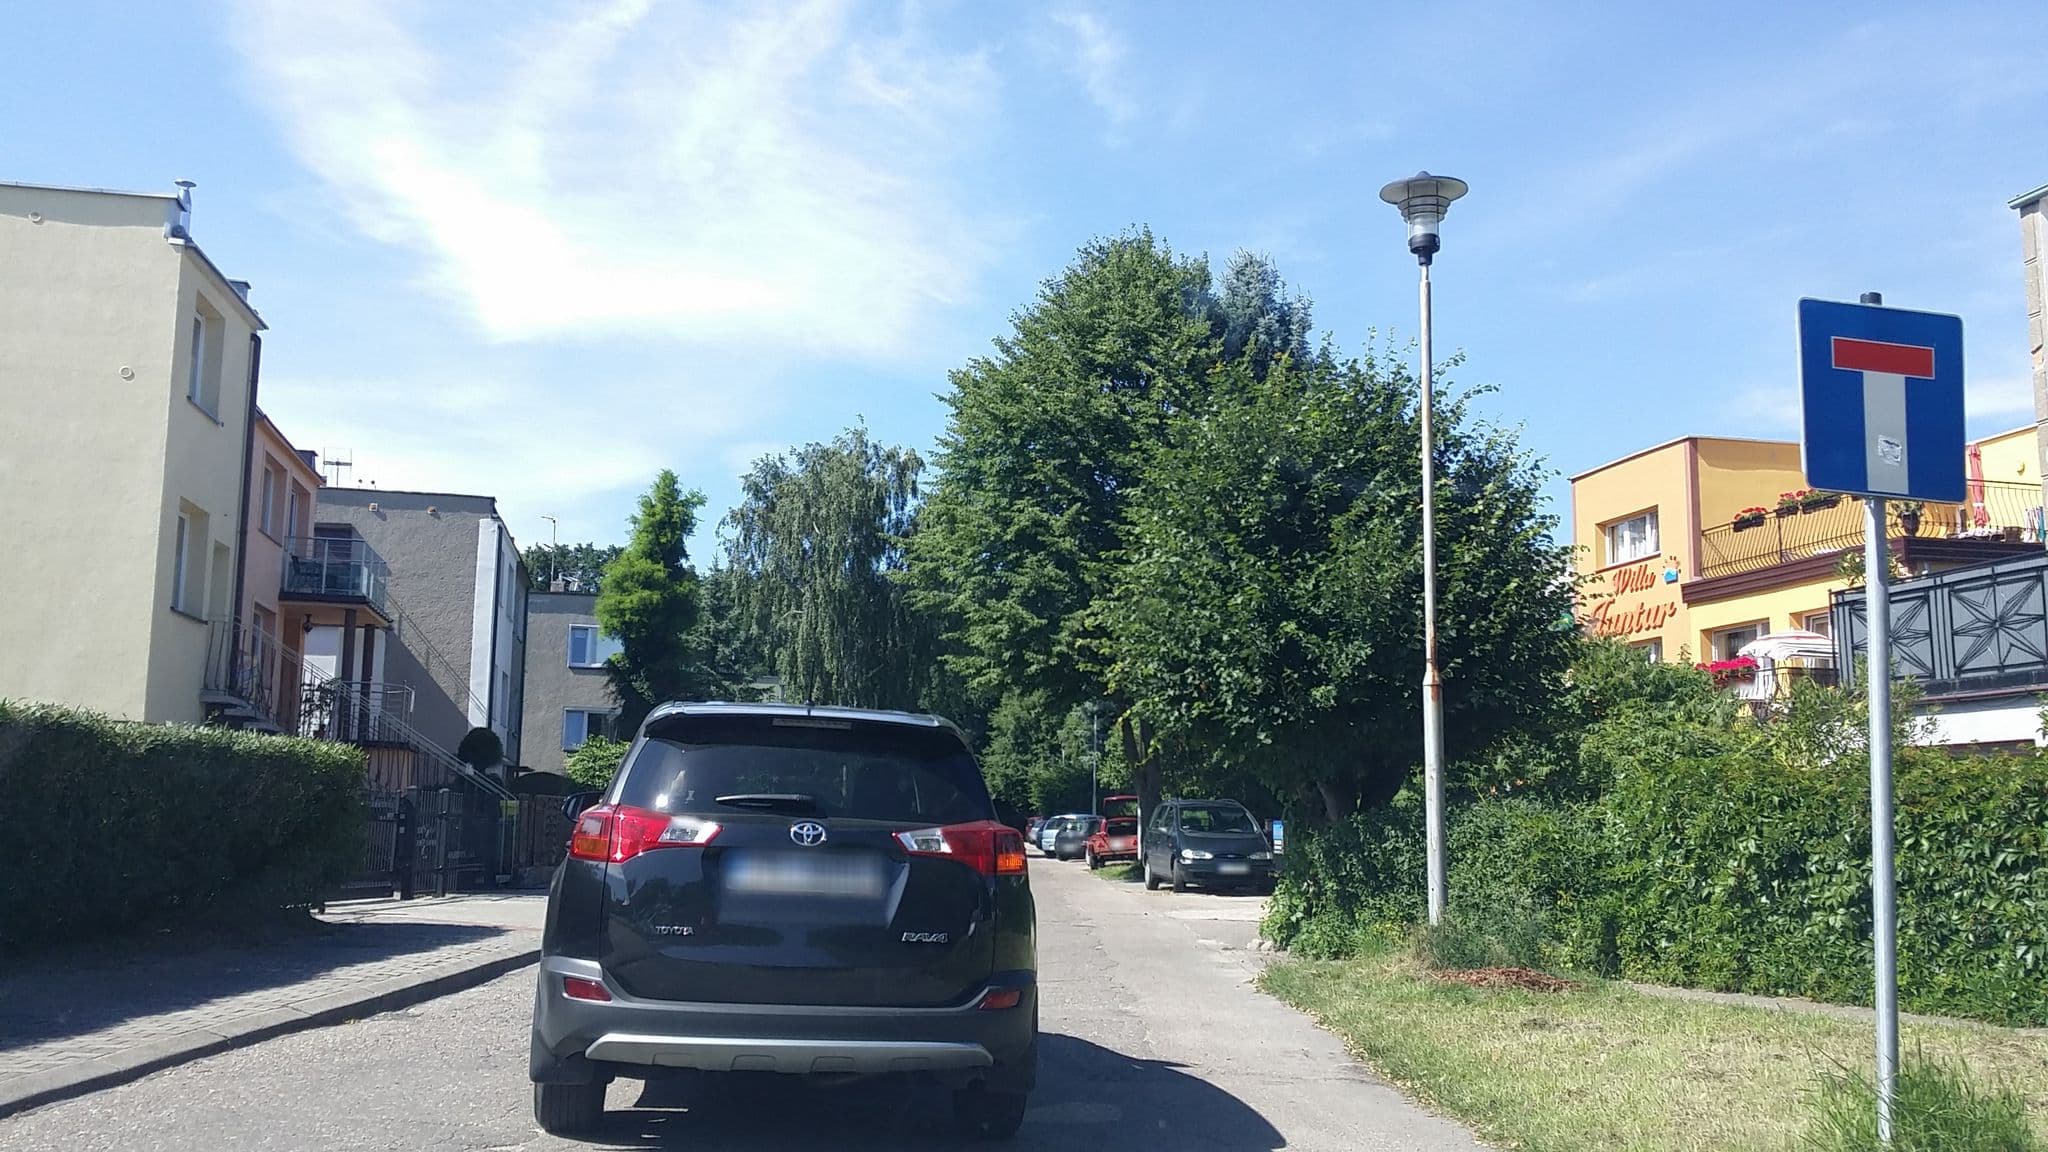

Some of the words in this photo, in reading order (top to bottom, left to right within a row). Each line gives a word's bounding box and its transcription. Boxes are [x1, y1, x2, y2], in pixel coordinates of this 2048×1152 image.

[1612, 564, 1657, 597] Willa
[655, 925, 694, 935] TOYOTA
[901, 932, 948, 943] RAV4
